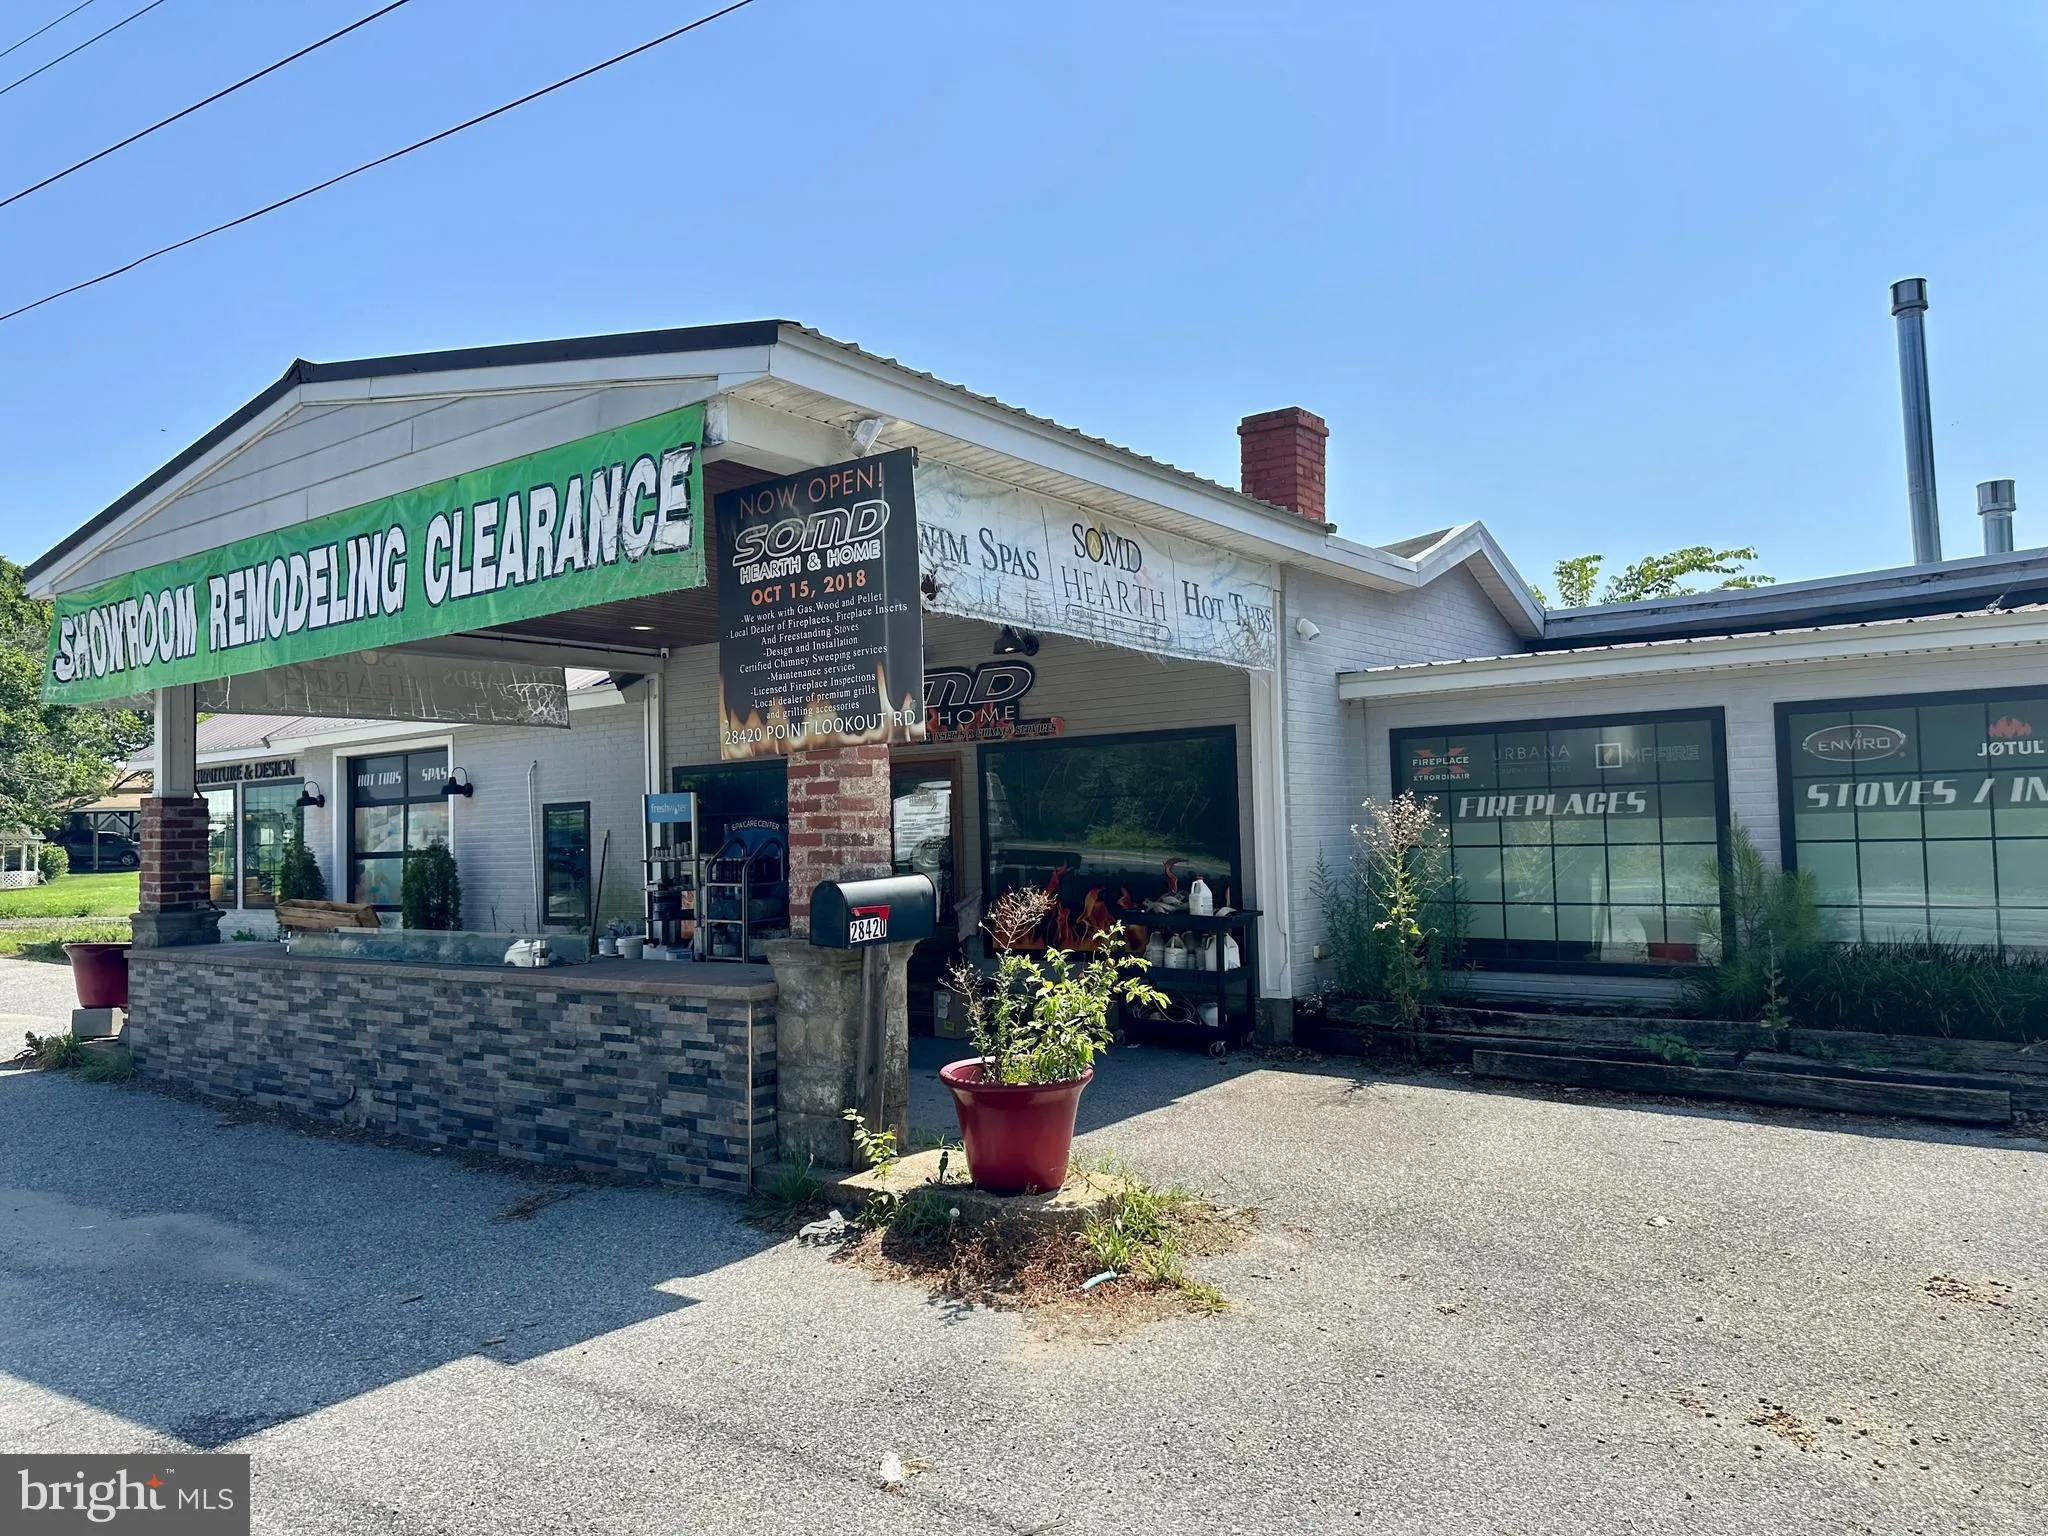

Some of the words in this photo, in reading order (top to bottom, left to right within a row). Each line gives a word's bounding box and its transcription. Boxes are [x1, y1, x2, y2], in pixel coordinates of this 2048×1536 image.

[740, 483, 798, 520] NOW
[808, 462, 884, 503] OPEN!
[733, 499, 891, 567] SOMD
[918, 523, 971, 565] WIM
[1072, 522, 1142, 574] SOMD
[53, 582, 198, 683] SHOWROOM
[208, 523, 407, 653] REMODELING
[423, 442, 697, 607] CLEARANCE
[739, 555, 801, 584] HEARTH
[807, 552, 822, 571] &
[827, 539, 881, 568] HOME
[751, 585, 781, 606] OCT
[790, 578, 816, 599] 15,
[823, 569, 867, 594] 2018
[1061, 566, 1166, 621] HEARTH
[757, 610, 775, 621] work
[778, 606, 795, 617] with
[842, 596, 855, 607] and
[857, 592, 883, 604] Pellet
[730, 627, 749, 639] Local
[751, 623, 775, 635] Dealer
[777, 620, 787, 630] of
[836, 607, 872, 621] Fireplace
[875, 602, 908, 614] Inserts
[761, 634, 777, 646] And
[779, 627, 832, 643] Freestanding
[835, 622, 860, 635] Stoves
[796, 642, 810, 652] and
[813, 635, 858, 650] Installation
[739, 661, 772, 674] Certified
[774, 656, 810, 670] Chimney
[812, 649, 851, 664] Sweeping
[853, 644, 888, 657] services
[823, 662, 856, 675] services
[790, 678, 828, 692] Fireplace
[830, 673, 876, 687] Inspections
[778, 693, 803, 706] dealer
[806, 692, 815, 703] of
[817, 688, 851, 703] premium
[853, 684, 876, 699] grills
[767, 709, 780, 720] and
[782, 705, 814, 720] grilling
[815, 700, 860, 715] accessories
[938, 705, 1015, 725] HOME
[725, 728, 762, 745] 28420
[767, 721, 810, 740] POINT
[815, 712, 887, 735] LOOKOUT
[893, 710, 916, 726] RD
[1015, 722, 1057, 735] SERVICES
[1492, 744, 1570, 760] URBANA
[1817, 736, 1891, 752] ENVIRO
[244, 764, 253, 780] &
[255, 758, 296, 779] DESIGN
[1412, 756, 1469, 766] FIREPLACE
[358, 773, 375, 787] HOT
[377, 771, 402, 786] TUBS
[421, 767, 447, 781] SPAS
[1413, 773, 1470, 782] XTRORDINAIR
[1458, 790, 1647, 818] FIREPLACES
[1807, 779, 1958, 808] STOVES
[731, 821, 743, 831] SPA
[743, 819, 757, 828] CARE
[758, 819, 779, 830] CENTER
[851, 919, 886, 942] 28420
